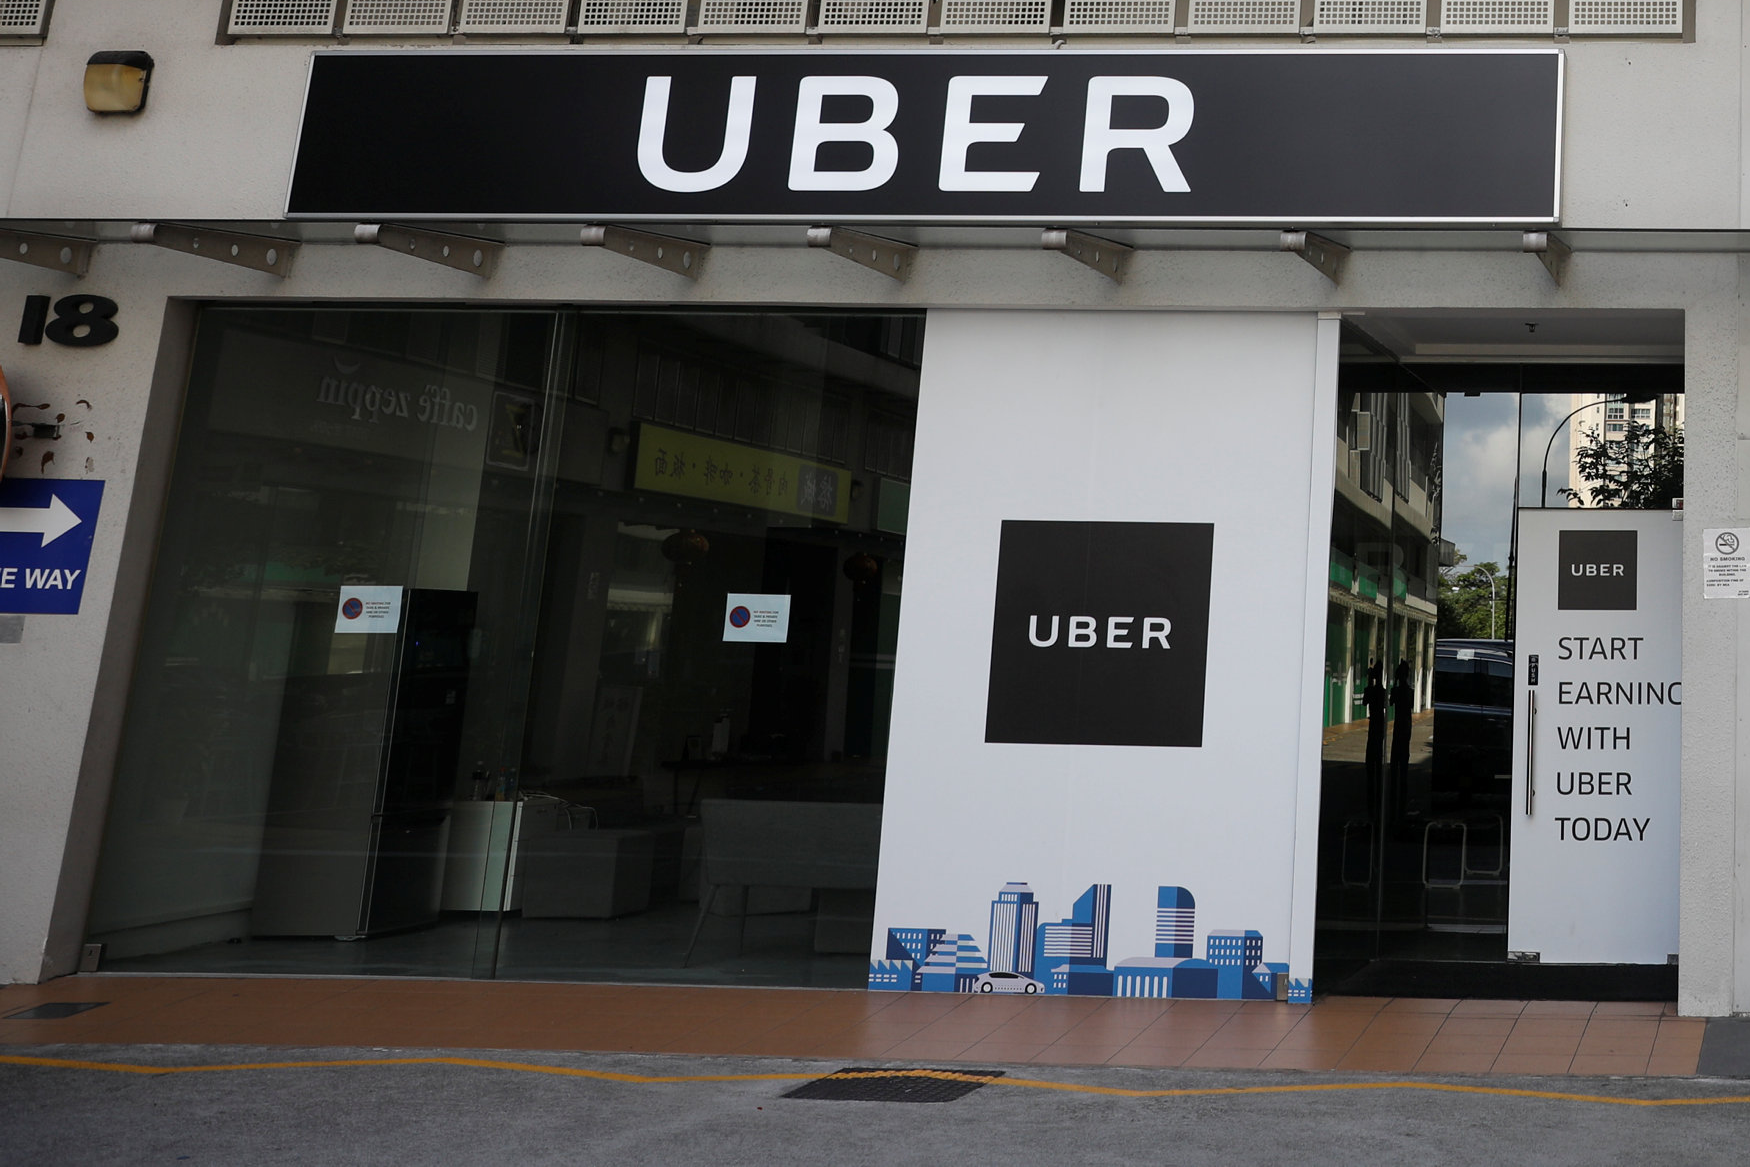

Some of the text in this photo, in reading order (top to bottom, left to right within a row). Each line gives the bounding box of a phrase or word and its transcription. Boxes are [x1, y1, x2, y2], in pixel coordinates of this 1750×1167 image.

[637, 75, 1195, 193] UBER
[17, 294, 119, 348] 18
[0, 567, 82, 590] E WAY
[1571, 563, 1624, 577] UBER
[1028, 615, 1172, 649] UBER
[1558, 636, 1644, 661] START
[1557, 726, 1631, 750] WITH
[1556, 771, 1633, 796] UBER
[1554, 817, 1651, 842] TODAY
